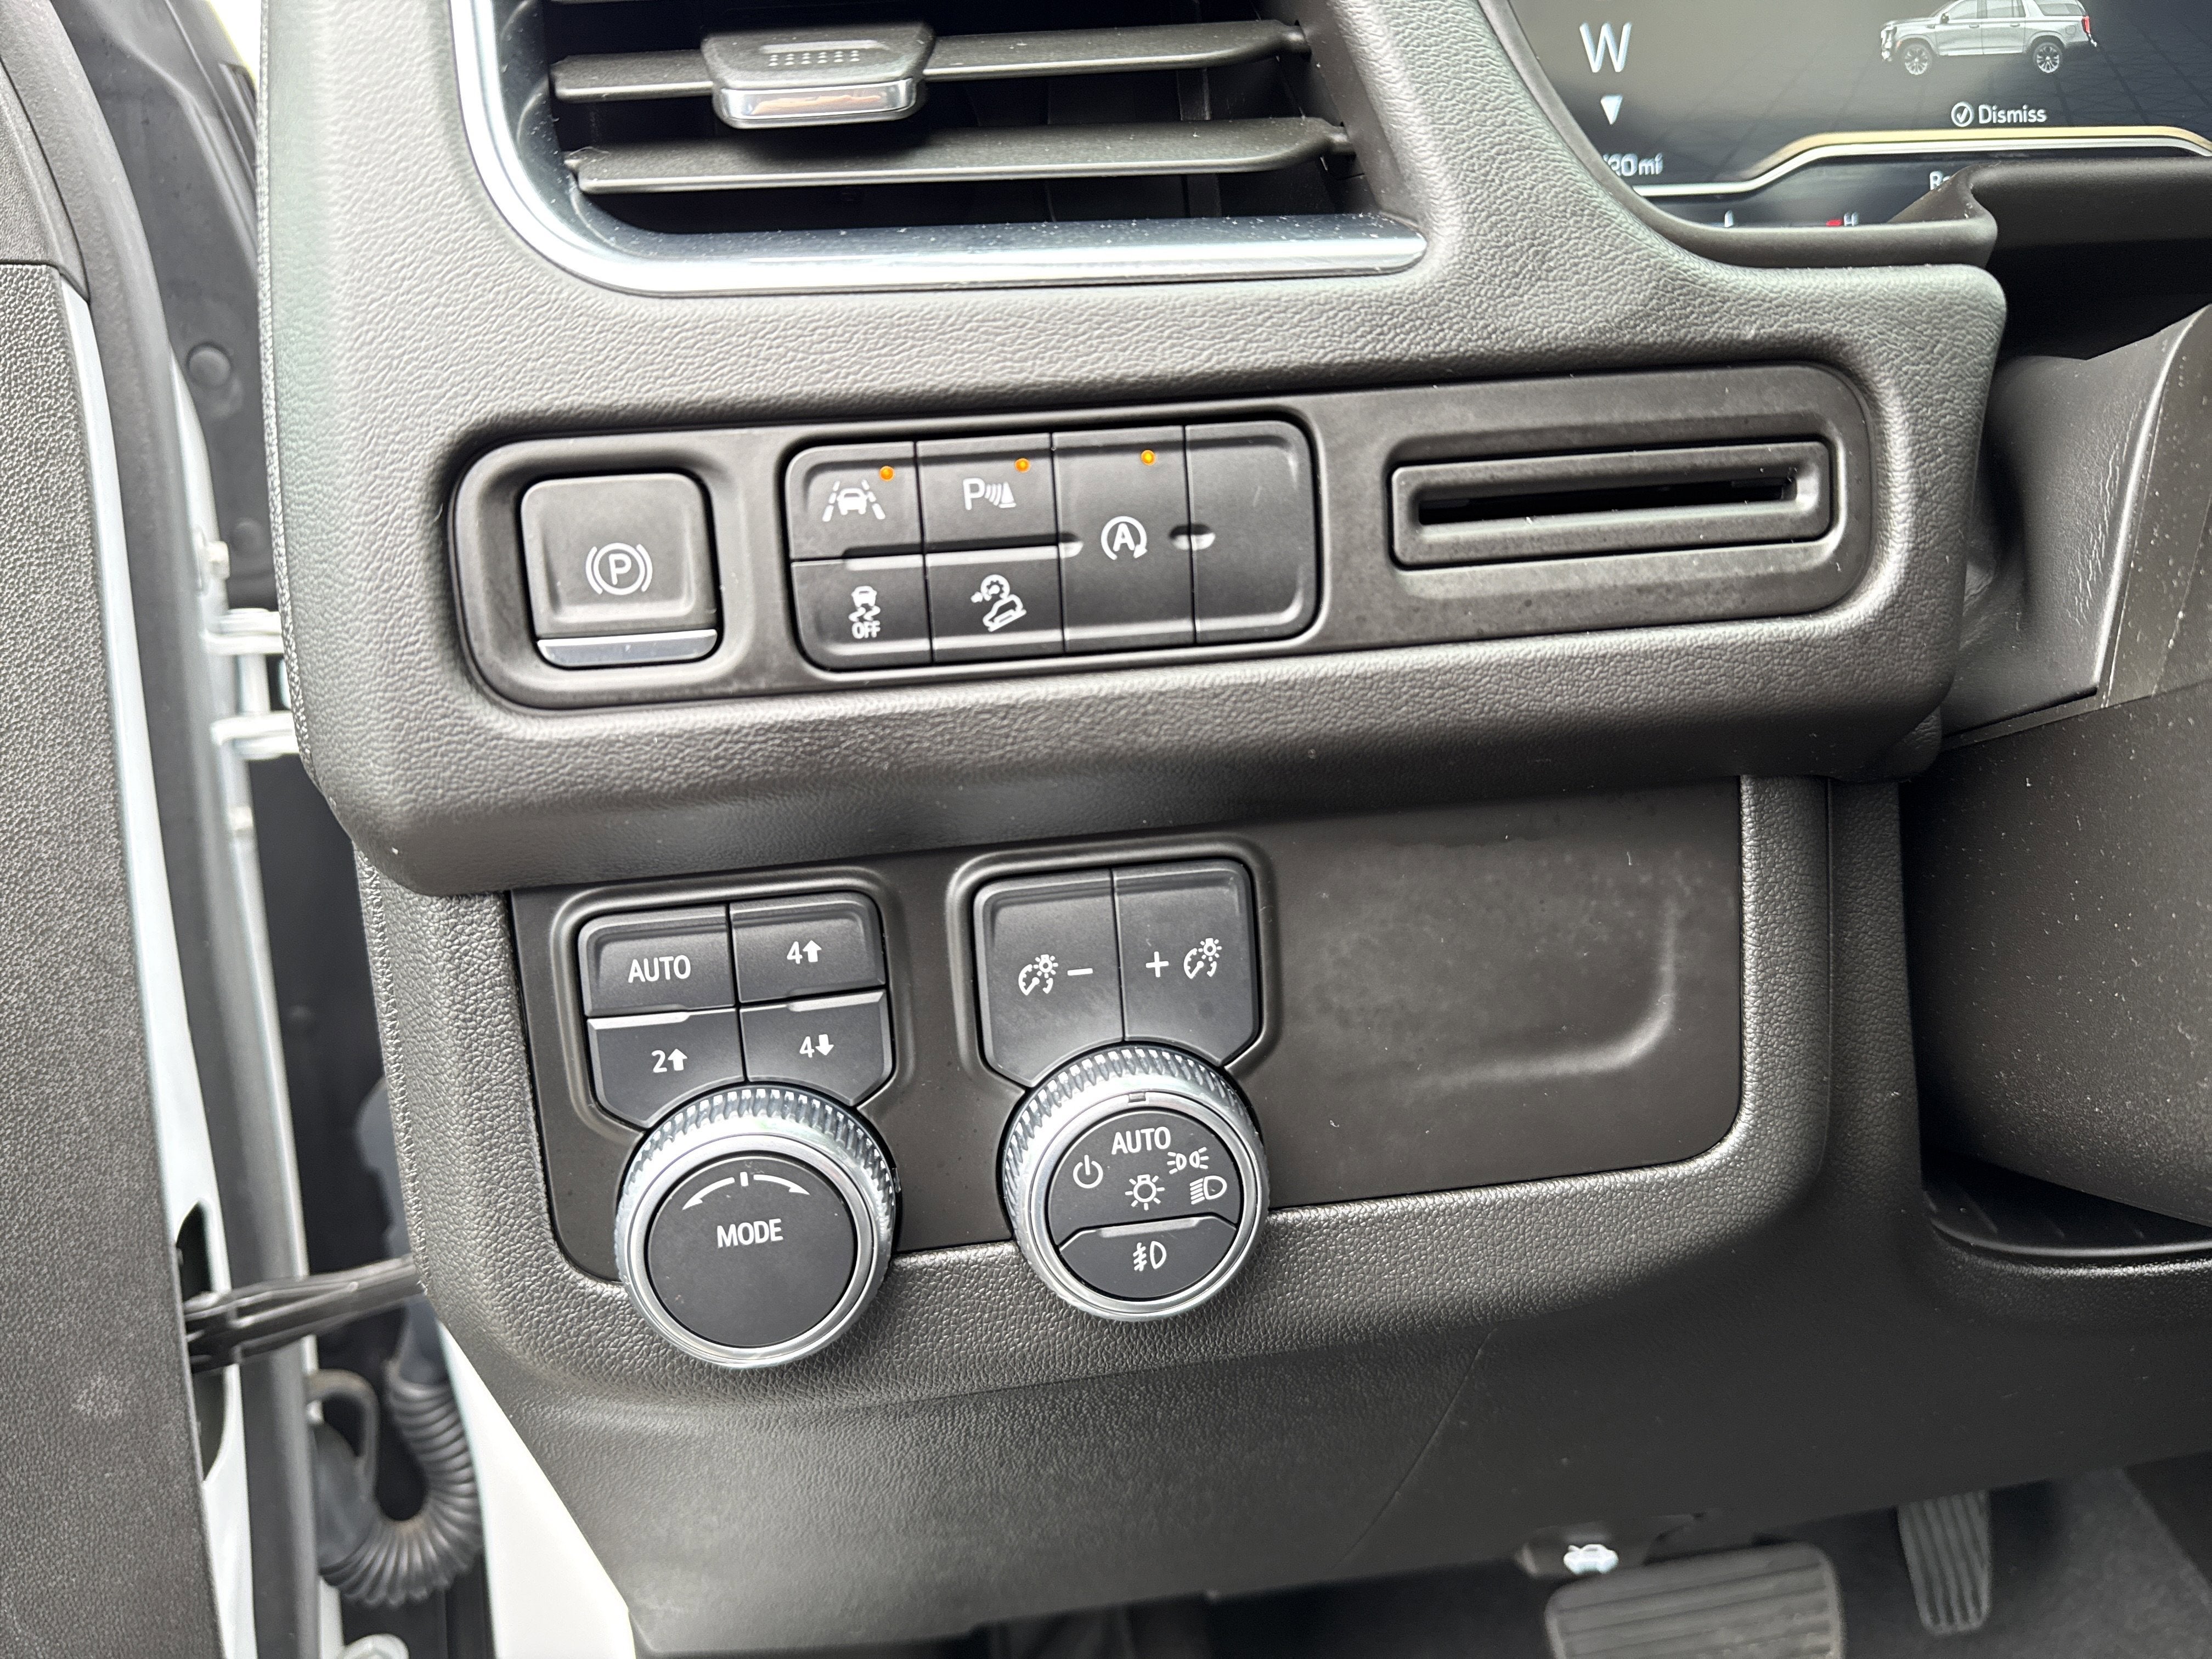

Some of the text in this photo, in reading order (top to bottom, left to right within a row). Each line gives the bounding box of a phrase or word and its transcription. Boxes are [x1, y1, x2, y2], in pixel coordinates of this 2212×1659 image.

[1579, 22, 1632, 73] W
[1978, 104, 2047, 124] Dismiss
[963, 477, 985, 510] P
[1113, 523, 1133, 552] A
[608, 553, 632, 585] P
[851, 620, 881, 639] OFF
[786, 941, 803, 964] 4
[628, 955, 692, 983] AUTO
[651, 1049, 668, 1073] 2
[799, 1036, 815, 1058] 4
[1111, 1126, 1171, 1155] AUTO
[717, 1218, 784, 1249] MODE
